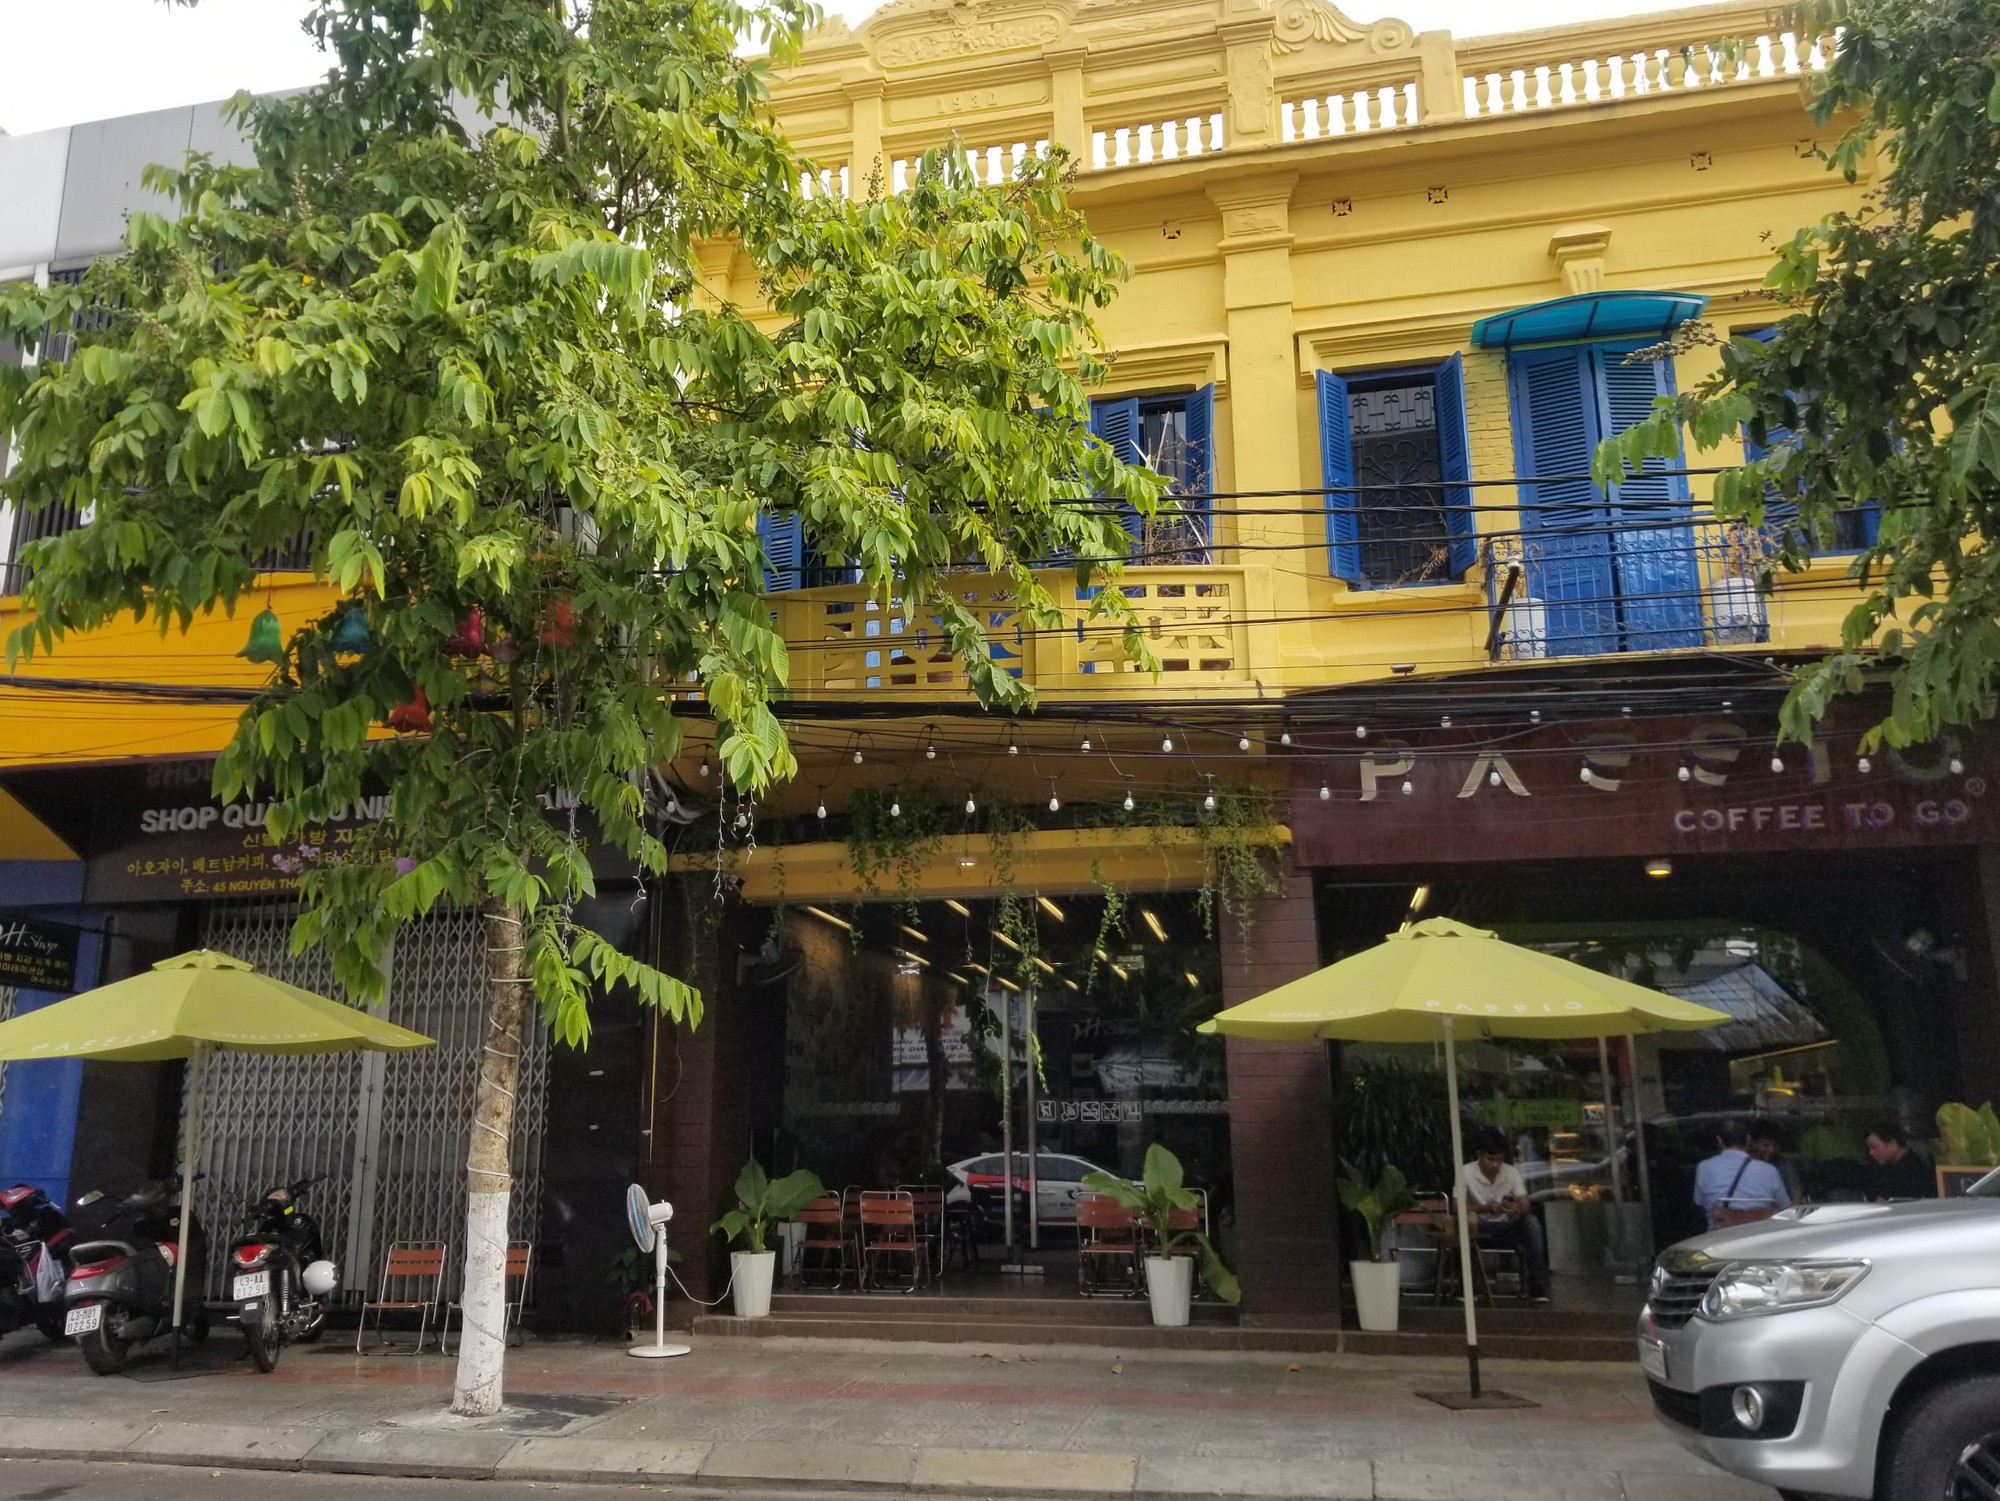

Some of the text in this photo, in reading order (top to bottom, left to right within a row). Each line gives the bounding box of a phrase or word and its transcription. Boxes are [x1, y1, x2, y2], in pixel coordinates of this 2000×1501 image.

[140, 806, 219, 834] SHOP
[1674, 800, 1969, 832] COFFEE TO GO
[212, 882, 227, 893] 45
[1426, 999, 1583, 1014] PASSIO
[31, 1029, 158, 1052] PASSIO
[66, 1318, 98, 1334] 022.59
